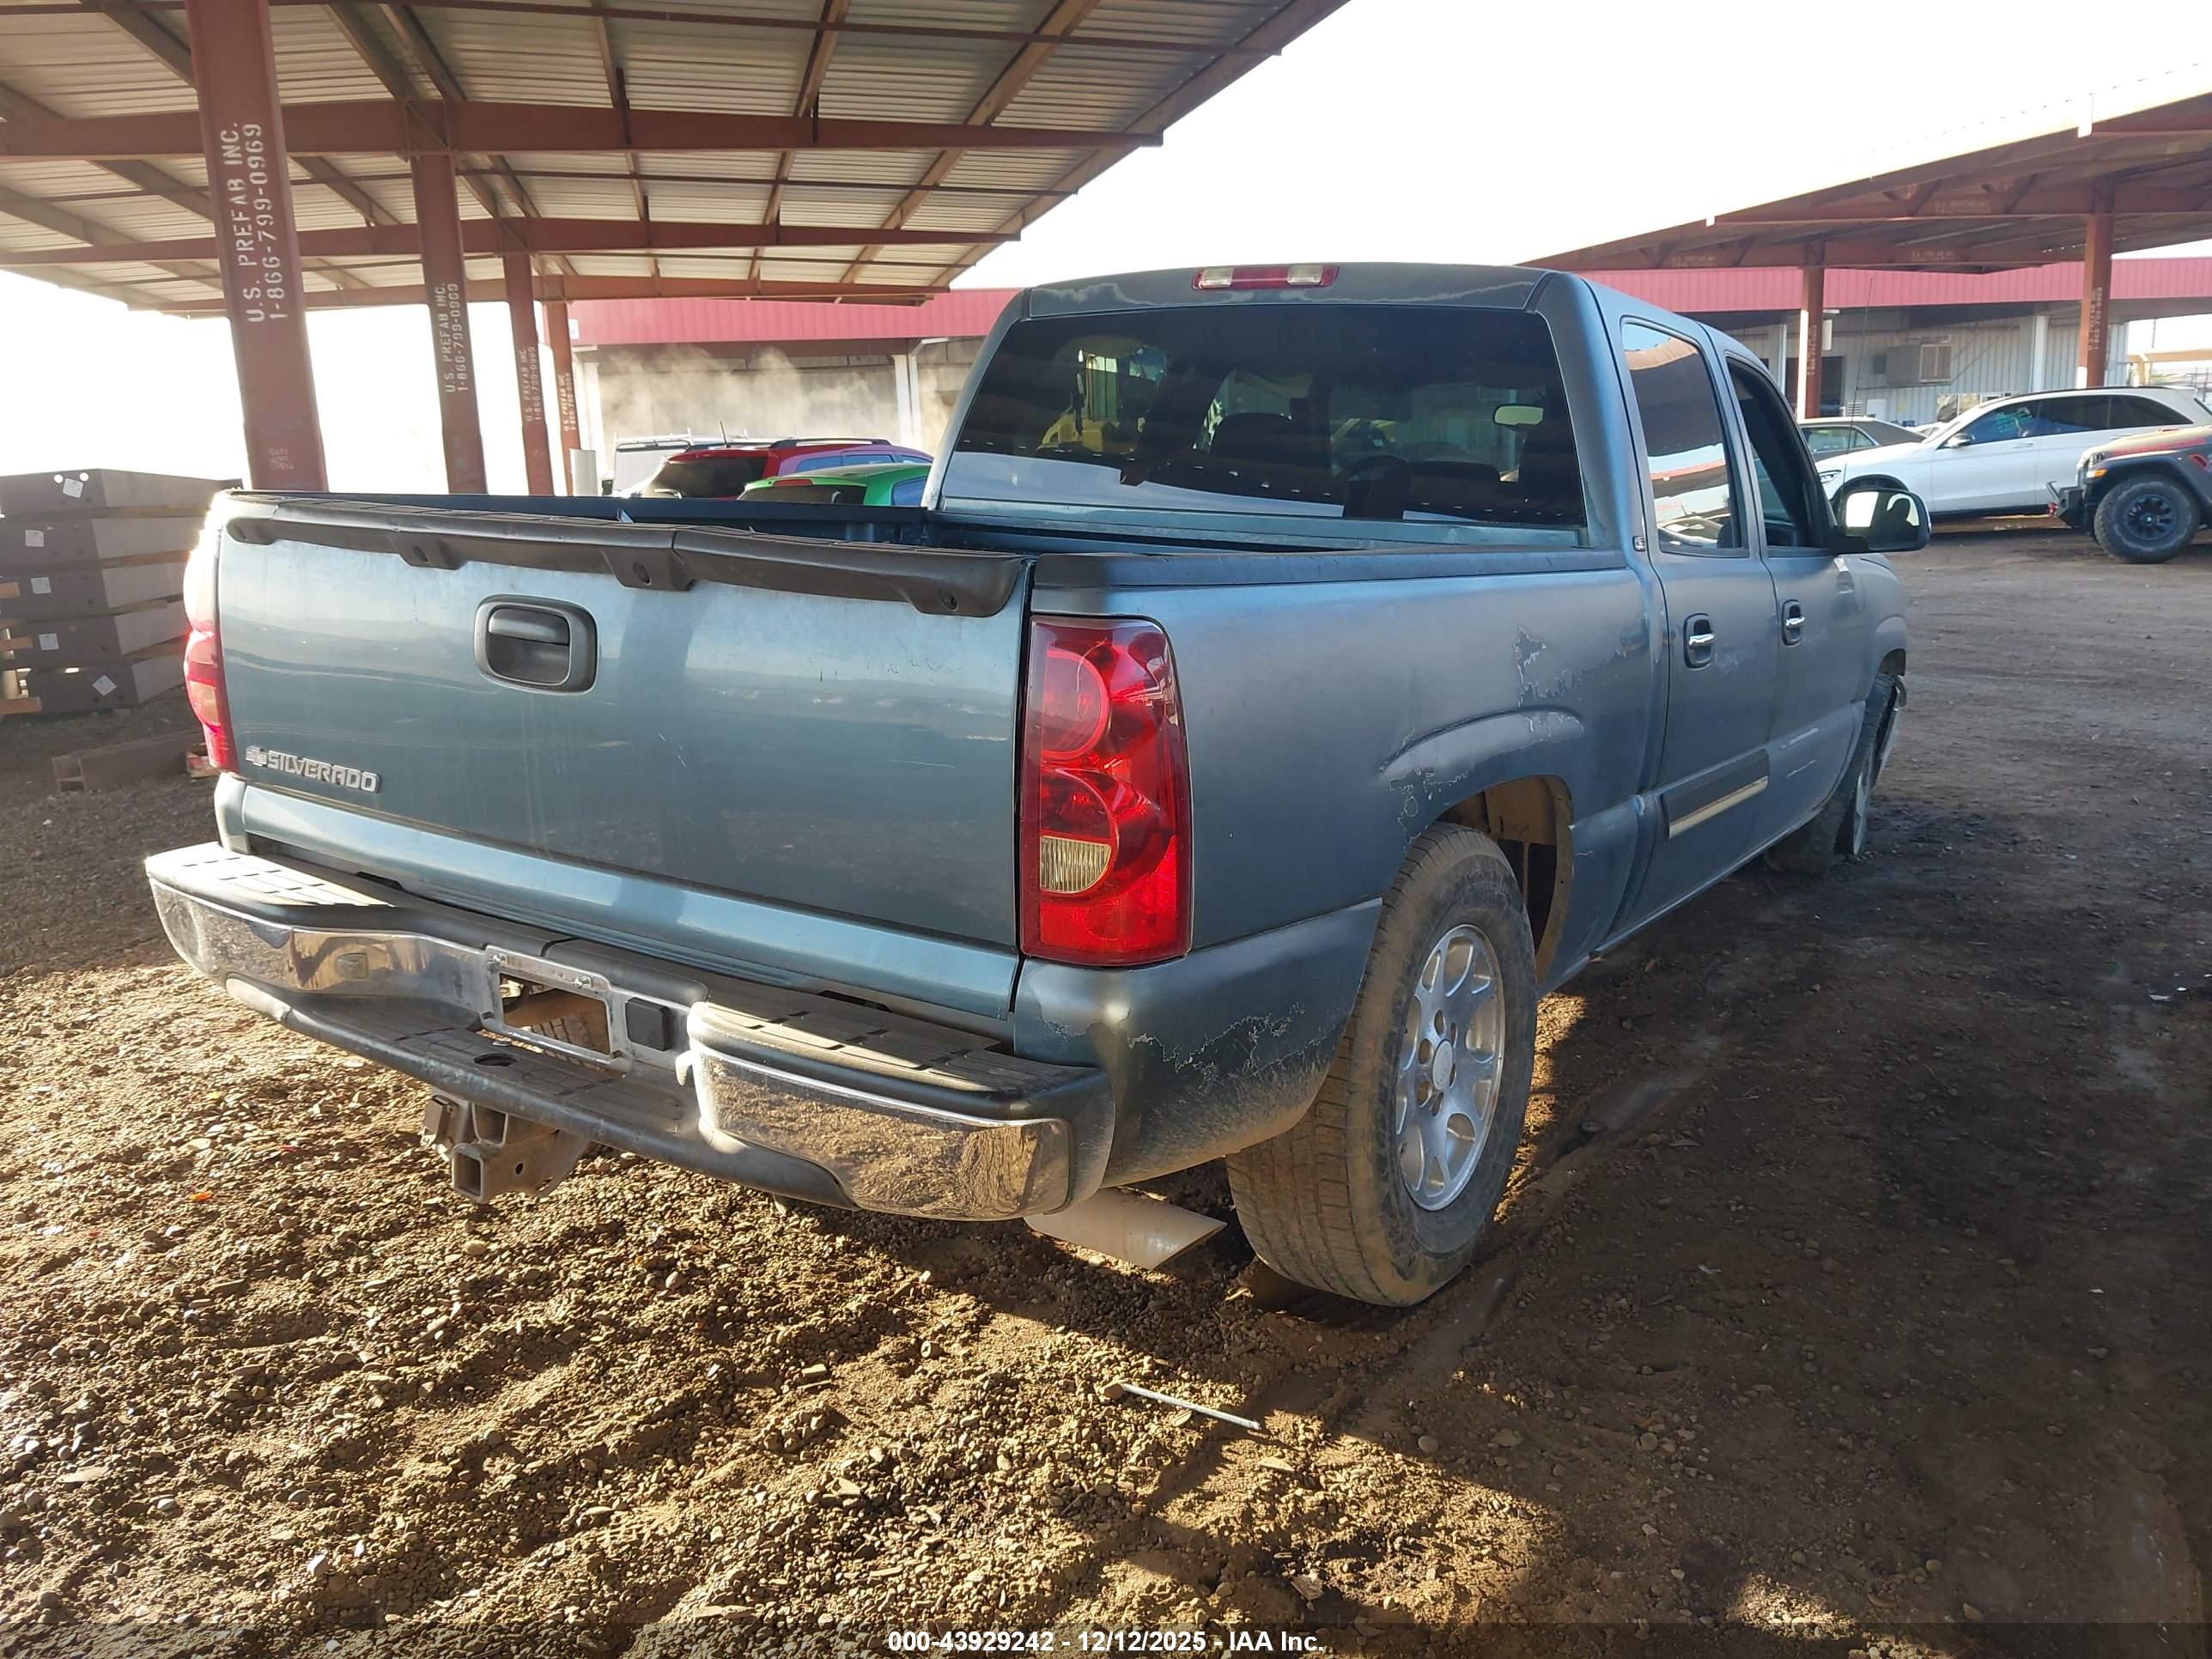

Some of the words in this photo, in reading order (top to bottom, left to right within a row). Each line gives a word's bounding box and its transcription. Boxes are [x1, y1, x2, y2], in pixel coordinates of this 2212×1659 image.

[220, 122, 243, 166] INC.
[228, 178, 257, 267] PREFAB
[243, 123, 289, 320] 1-866-799-0969
[243, 280, 265, 323] U.S.
[438, 313, 453, 362] PREFAB
[267, 750, 380, 793] SILVERADO
